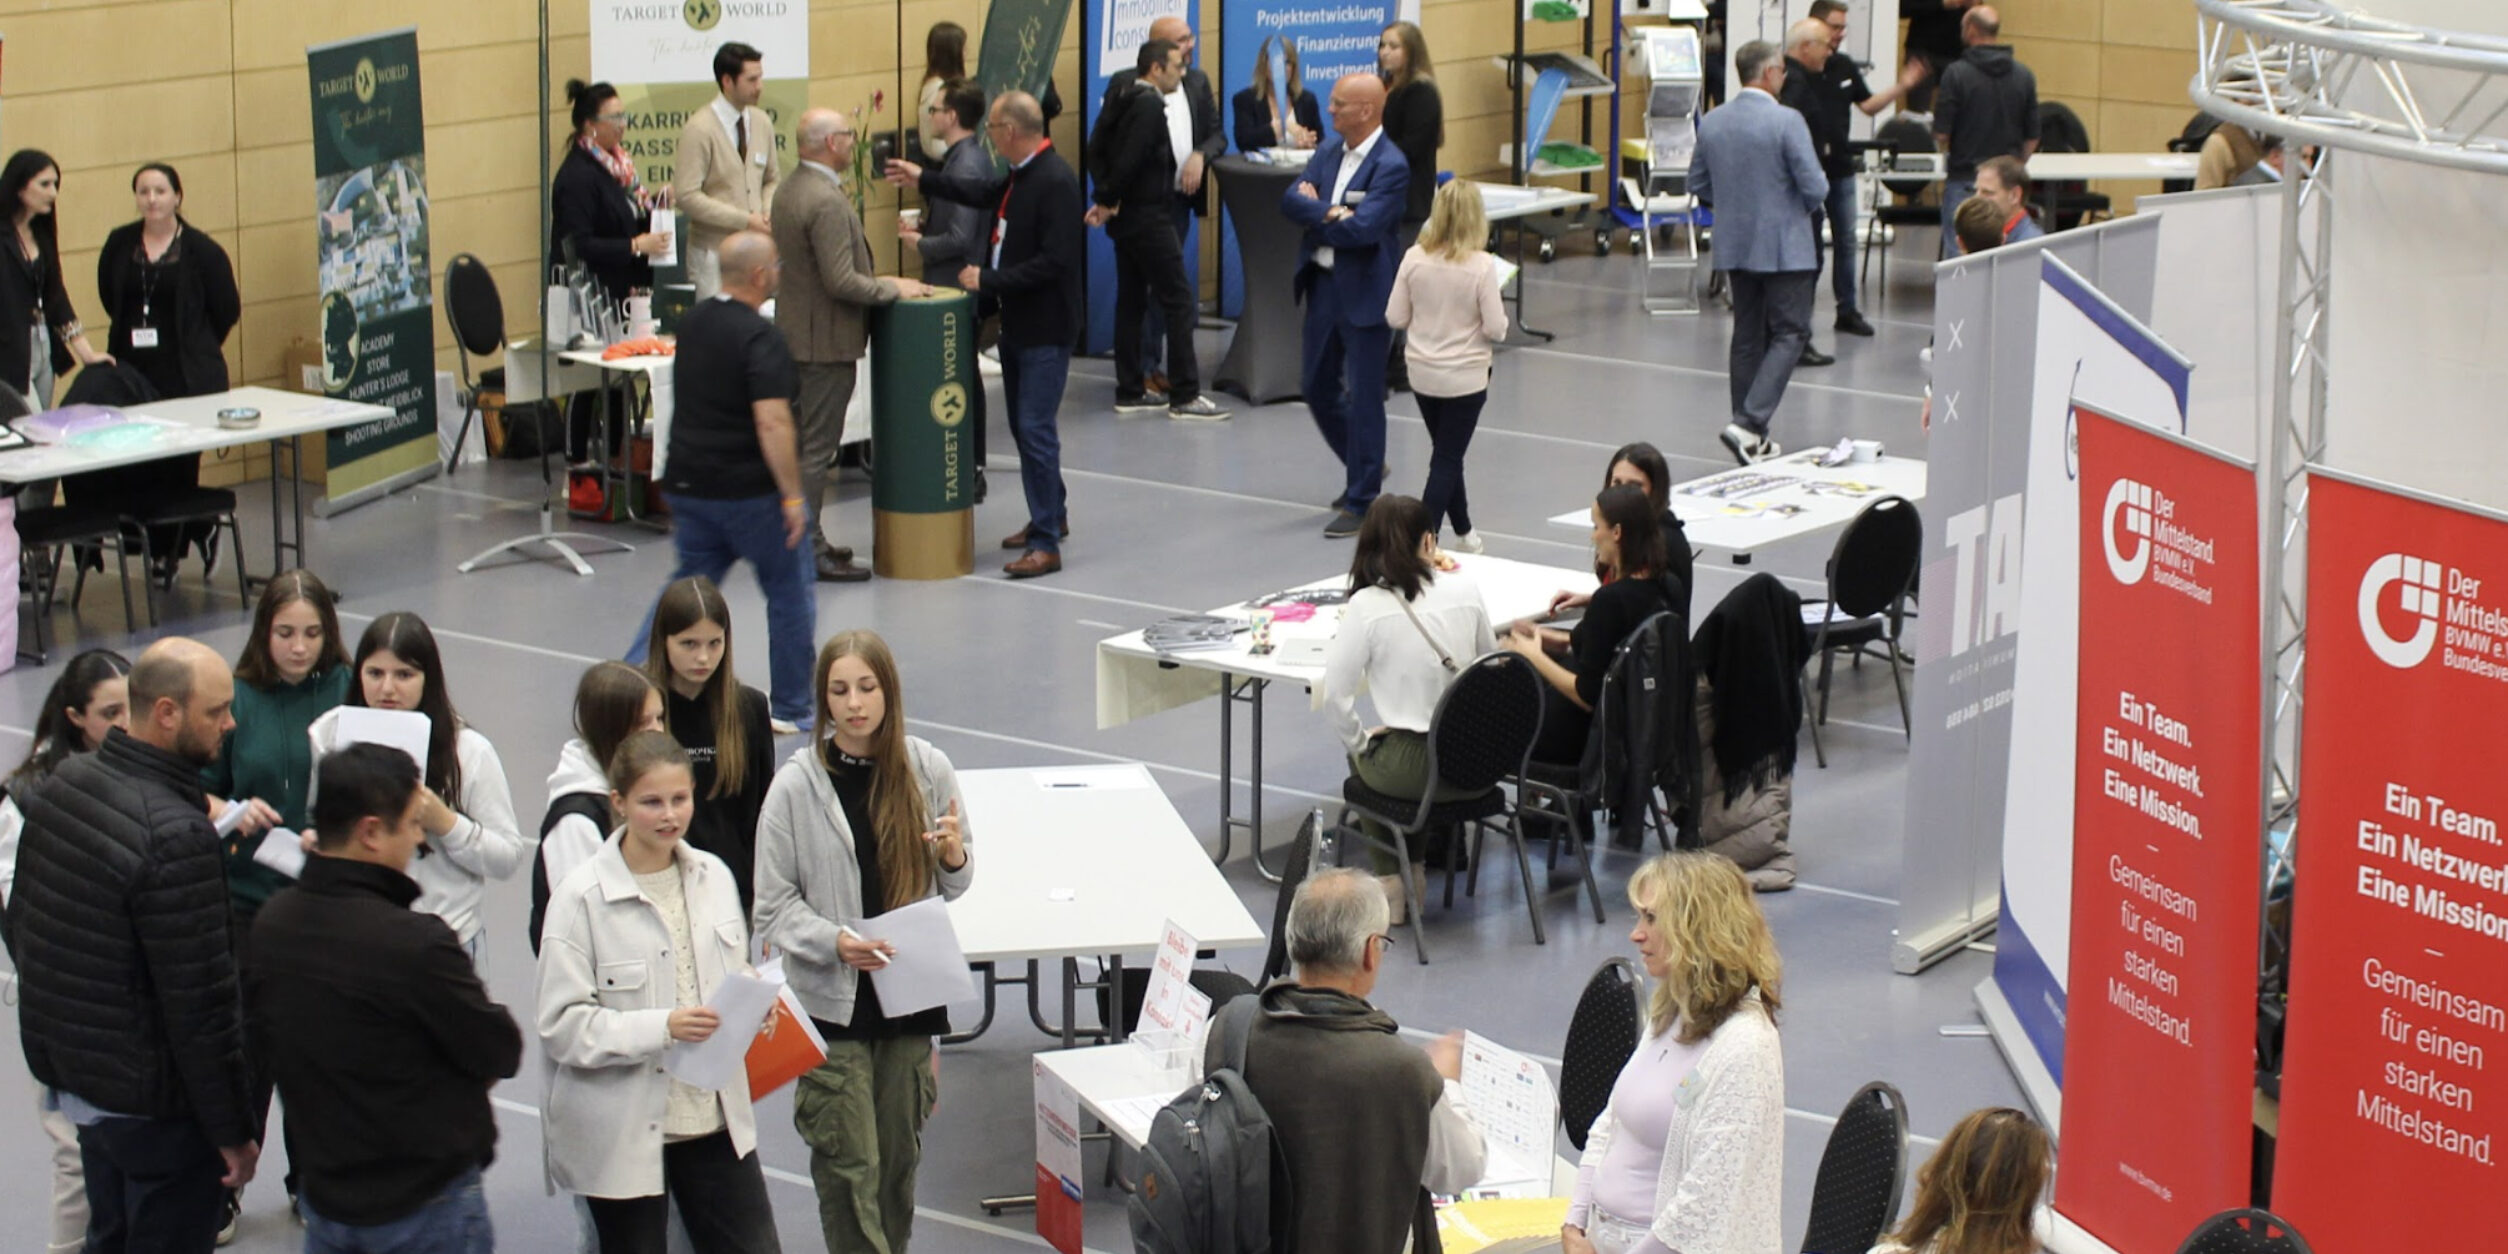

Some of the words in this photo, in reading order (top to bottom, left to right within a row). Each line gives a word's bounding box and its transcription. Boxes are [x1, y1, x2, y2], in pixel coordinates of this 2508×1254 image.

[612, 5, 679, 22] TARGET
[726, 2, 787, 18] WORLD
[1257, 4, 1385, 30] Projektentwicklung
[1297, 34, 1380, 54] Finanzierung
[319, 74, 354, 98] TARGET
[377, 63, 409, 84] WORLD
[1305, 61, 1378, 81] Investment
[360, 332, 395, 355] ACADEMY
[366, 354, 391, 375] STORE
[943, 311, 957, 380] WORLD
[387, 368, 409, 390] LODGE
[945, 430, 958, 502] TARGET
[2154, 490, 2175, 519] Der
[2153, 543, 2182, 571] BVMW
[2153, 563, 2212, 605] Bundesverband
[2447, 567, 2481, 600] Der
[2445, 625, 2492, 654] BVMW
[2120, 690, 2144, 727] Ein
[2145, 702, 2192, 748] Team.
[2104, 726, 2129, 762] Ein
[2131, 738, 2204, 798] Netzwerk.
[2104, 768, 2138, 808] Eine
[2140, 785, 2203, 840] Mission.
[2385, 782, 2422, 821] Ein
[2425, 795, 2503, 847] Team.
[2358, 820, 2397, 859] Ein
[2109, 854, 2197, 922] Gemeinsam
[2358, 865, 2410, 908] Eine
[2120, 900, 2141, 935] für
[2143, 917, 2184, 958] einen
[2124, 950, 2178, 997] starken
[2363, 957, 2506, 1033] Gemeinsam
[2108, 976, 2194, 1048] Mittelstand.
[2380, 1006, 2412, 1045] für
[2416, 1026, 2483, 1070] einen
[2384, 1061, 2473, 1112] starken
[2357, 1089, 2496, 1167] Mittelstand.
